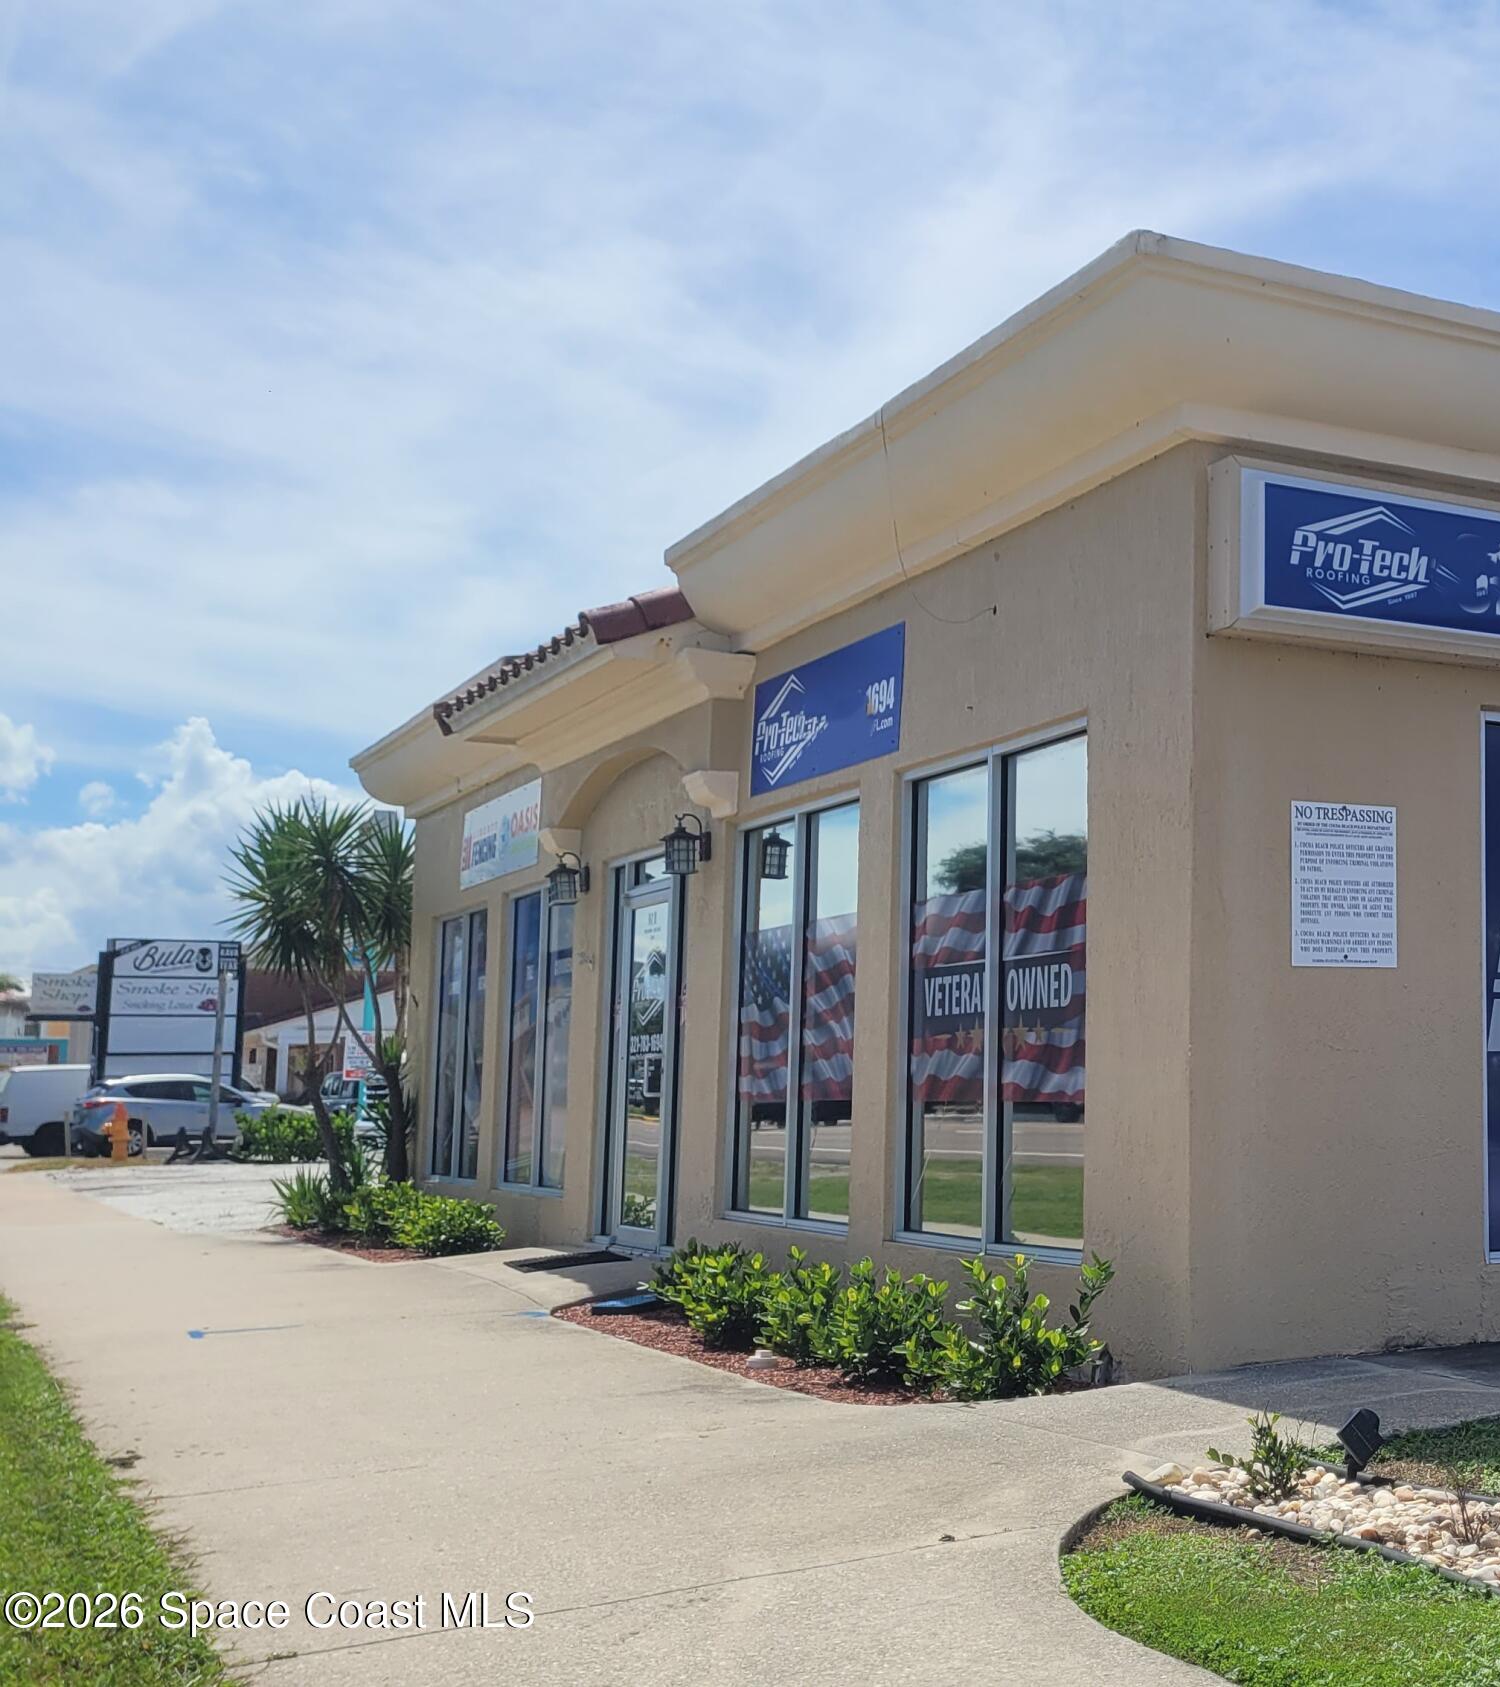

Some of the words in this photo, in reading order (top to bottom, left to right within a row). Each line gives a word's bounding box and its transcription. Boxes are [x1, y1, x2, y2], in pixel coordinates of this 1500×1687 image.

[1290, 530, 1430, 583] Pro-Tech
[1306, 567, 1371, 585] ROOFING
[866, 676, 895, 716] 1694
[1294, 805, 1312, 819] NO
[1315, 806, 1393, 824] TRESPASSING
[133, 943, 195, 971] Bula
[116, 982, 180, 996] Smoke
[925, 972, 986, 1017] VETERA
[1006, 963, 1073, 1011] OWNED
